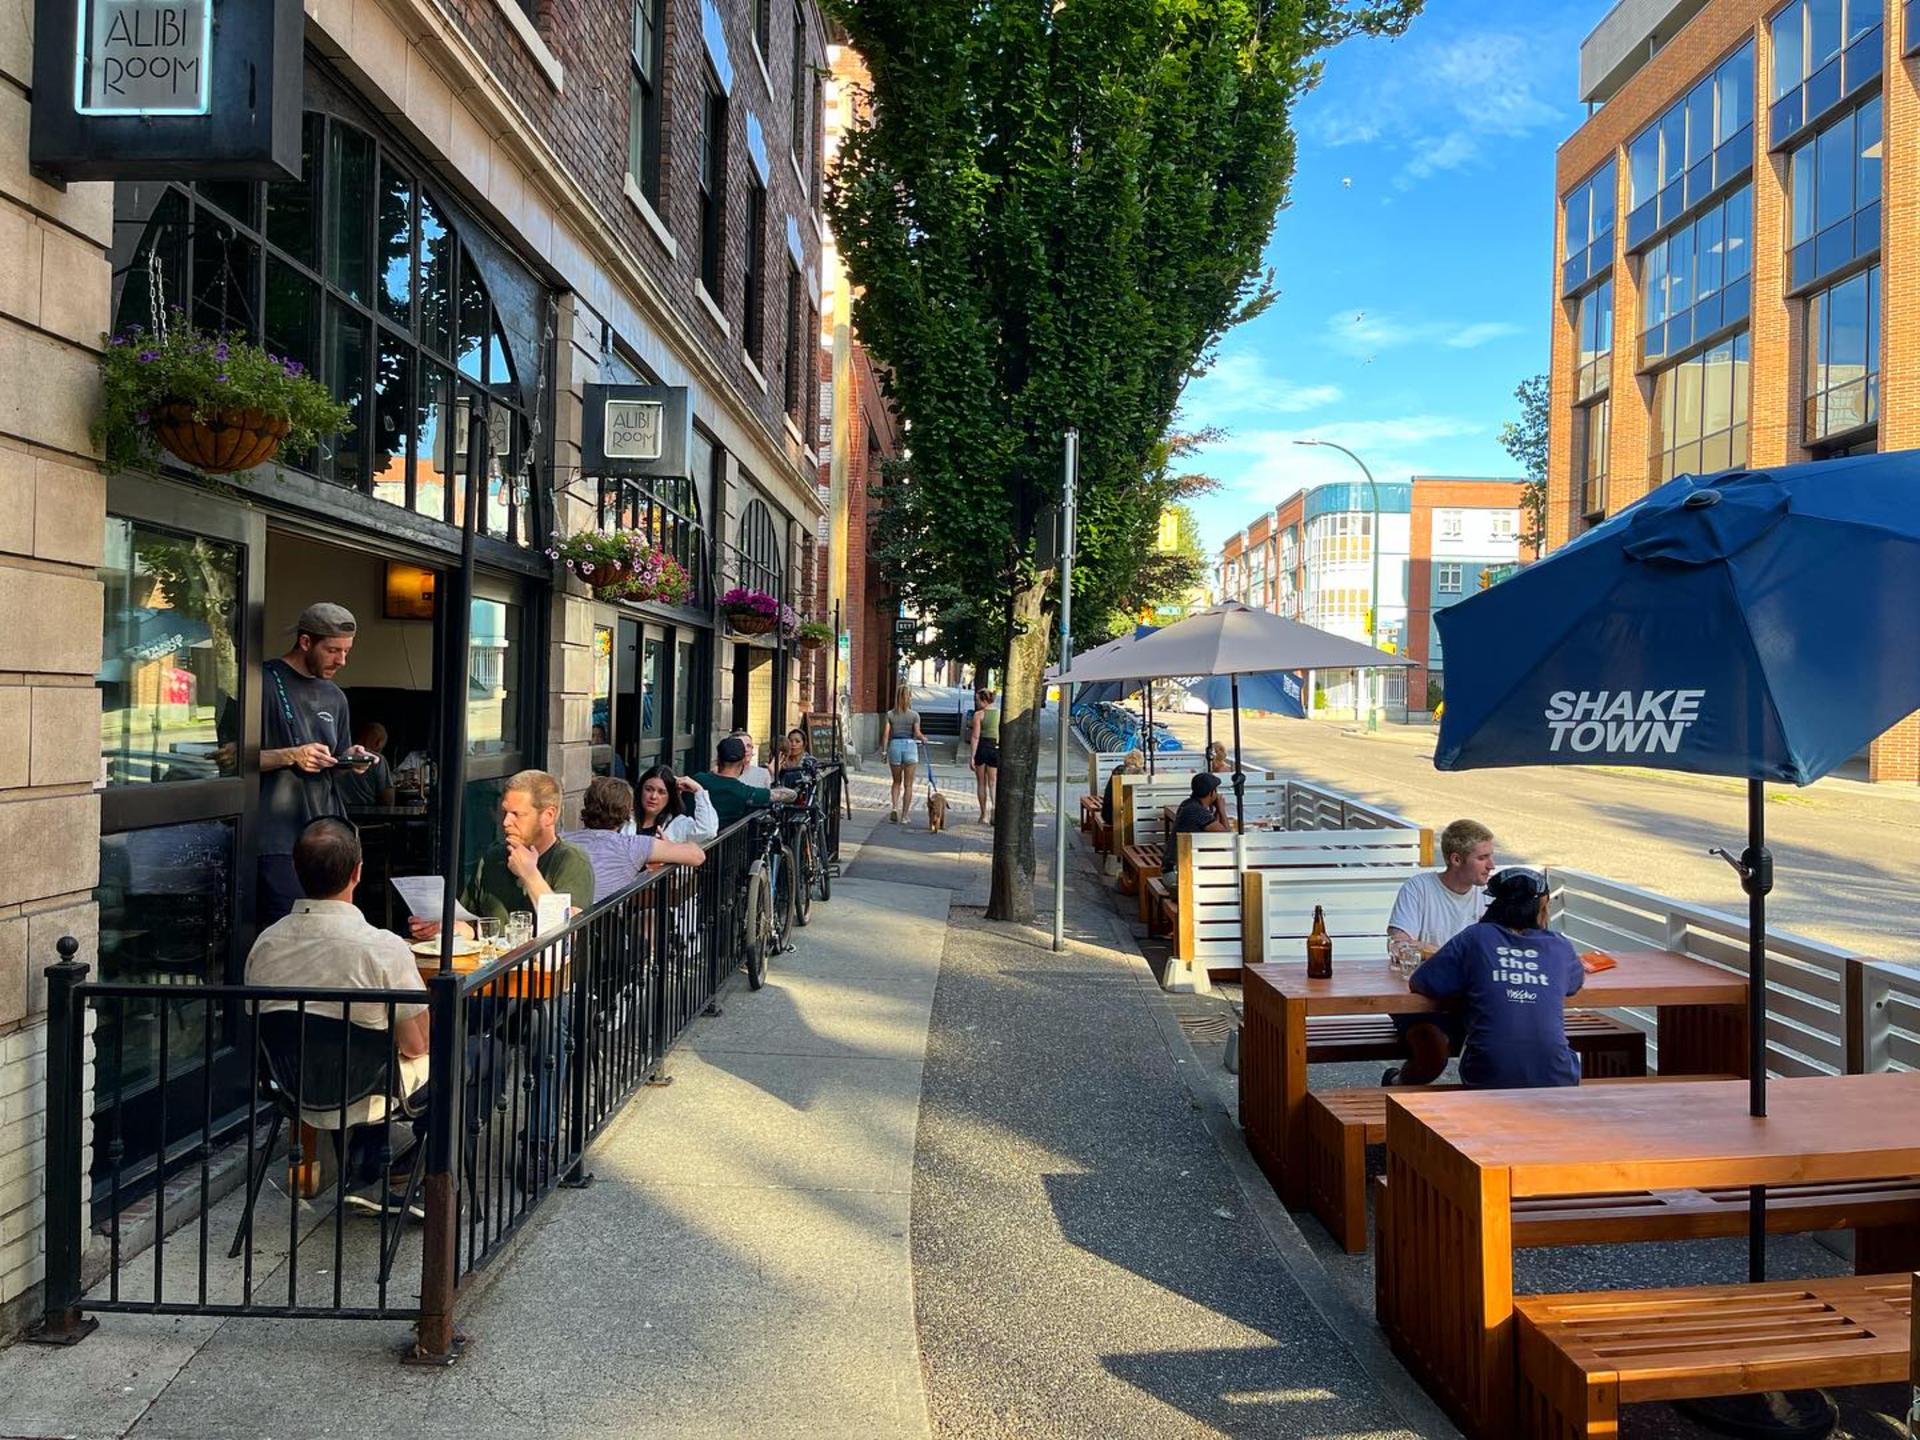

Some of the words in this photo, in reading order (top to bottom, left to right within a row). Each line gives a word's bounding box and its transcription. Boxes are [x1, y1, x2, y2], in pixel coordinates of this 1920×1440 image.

[104, 9, 187, 47] ALIBI
[103, 57, 199, 95] ROOM
[612, 411, 650, 429] ALIBI
[612, 431, 656, 449] ROOM
[1544, 689, 1706, 721] SHAKE
[1547, 721, 1687, 753] TOWN
[1495, 946, 1539, 958] see
[1498, 957, 1539, 970] the
[1492, 970, 1549, 986] light
